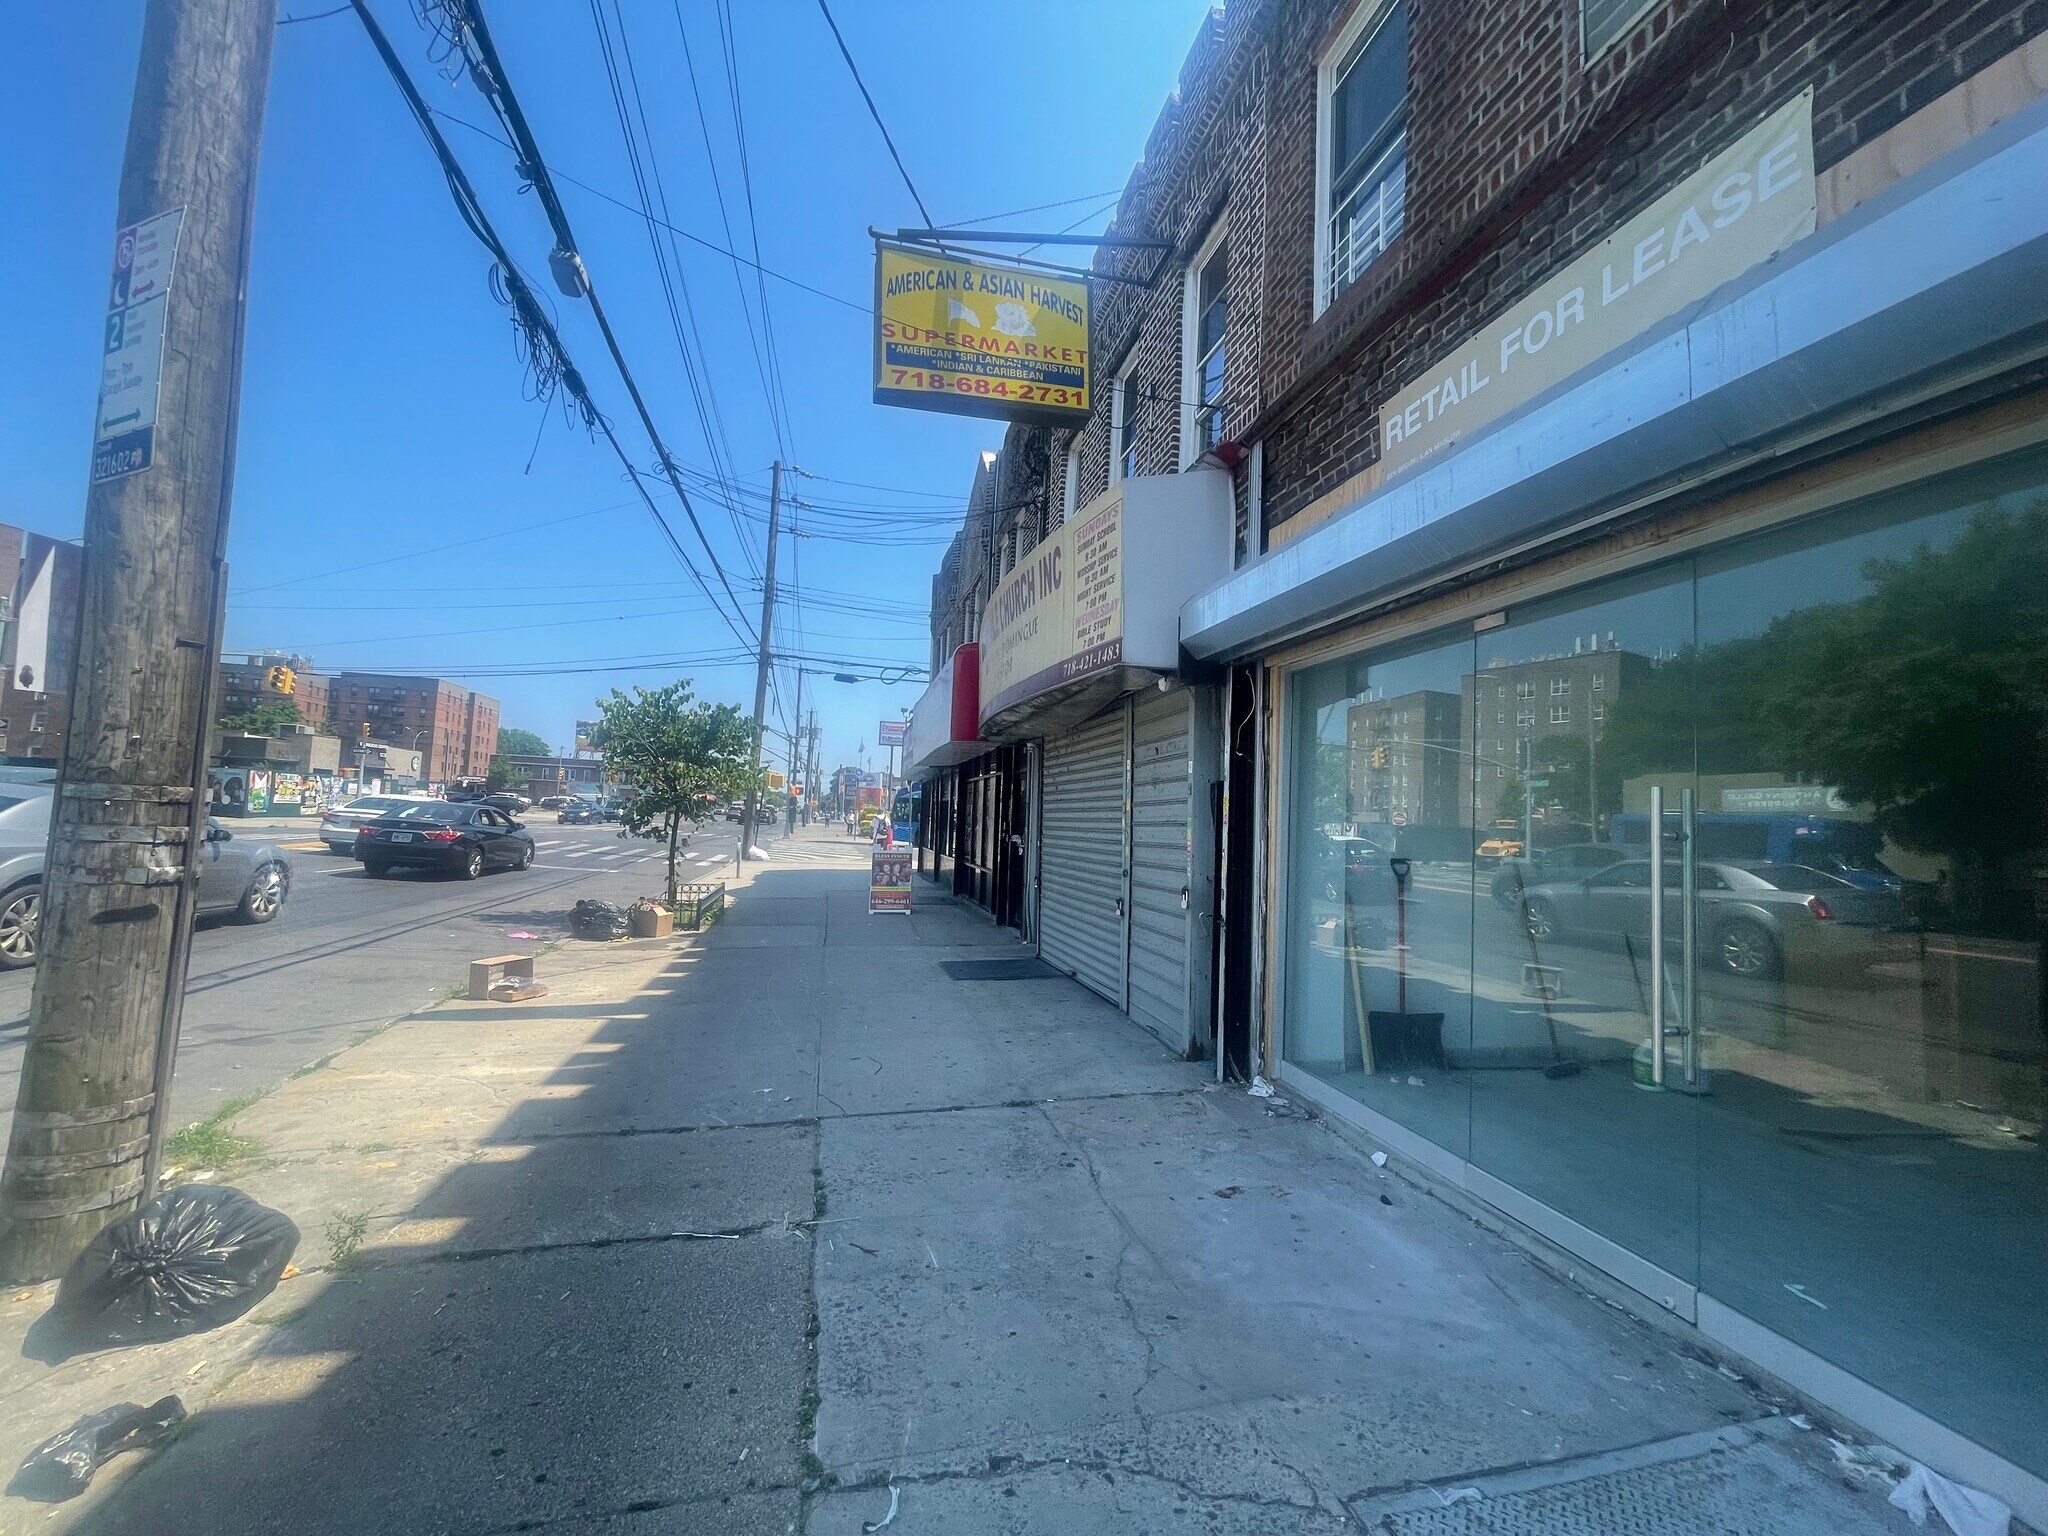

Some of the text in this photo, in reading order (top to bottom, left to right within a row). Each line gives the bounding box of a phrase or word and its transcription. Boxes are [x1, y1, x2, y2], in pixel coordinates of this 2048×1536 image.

[886, 269, 1084, 327] AMERICAN & ASIAN HARVEST
[1385, 132, 1802, 451] RETAIL FOR LEASE
[882, 323, 1088, 364] SUPERMARKET
[979, 353, 1022, 368] LANKAN
[890, 369, 1083, 406] 718-684-2731
[975, 364, 984, 373] &
[986, 365, 1044, 380] CARIBBEAN
[95, 450, 131, 478] 321602
[1077, 504, 1120, 543] SUNDAYS
[999, 566, 1035, 633] CHURCH
[1039, 545, 1062, 600] INC
[1075, 597, 1120, 629] WEDNESDAY
[1063, 643, 1120, 677] 718-421-1483
